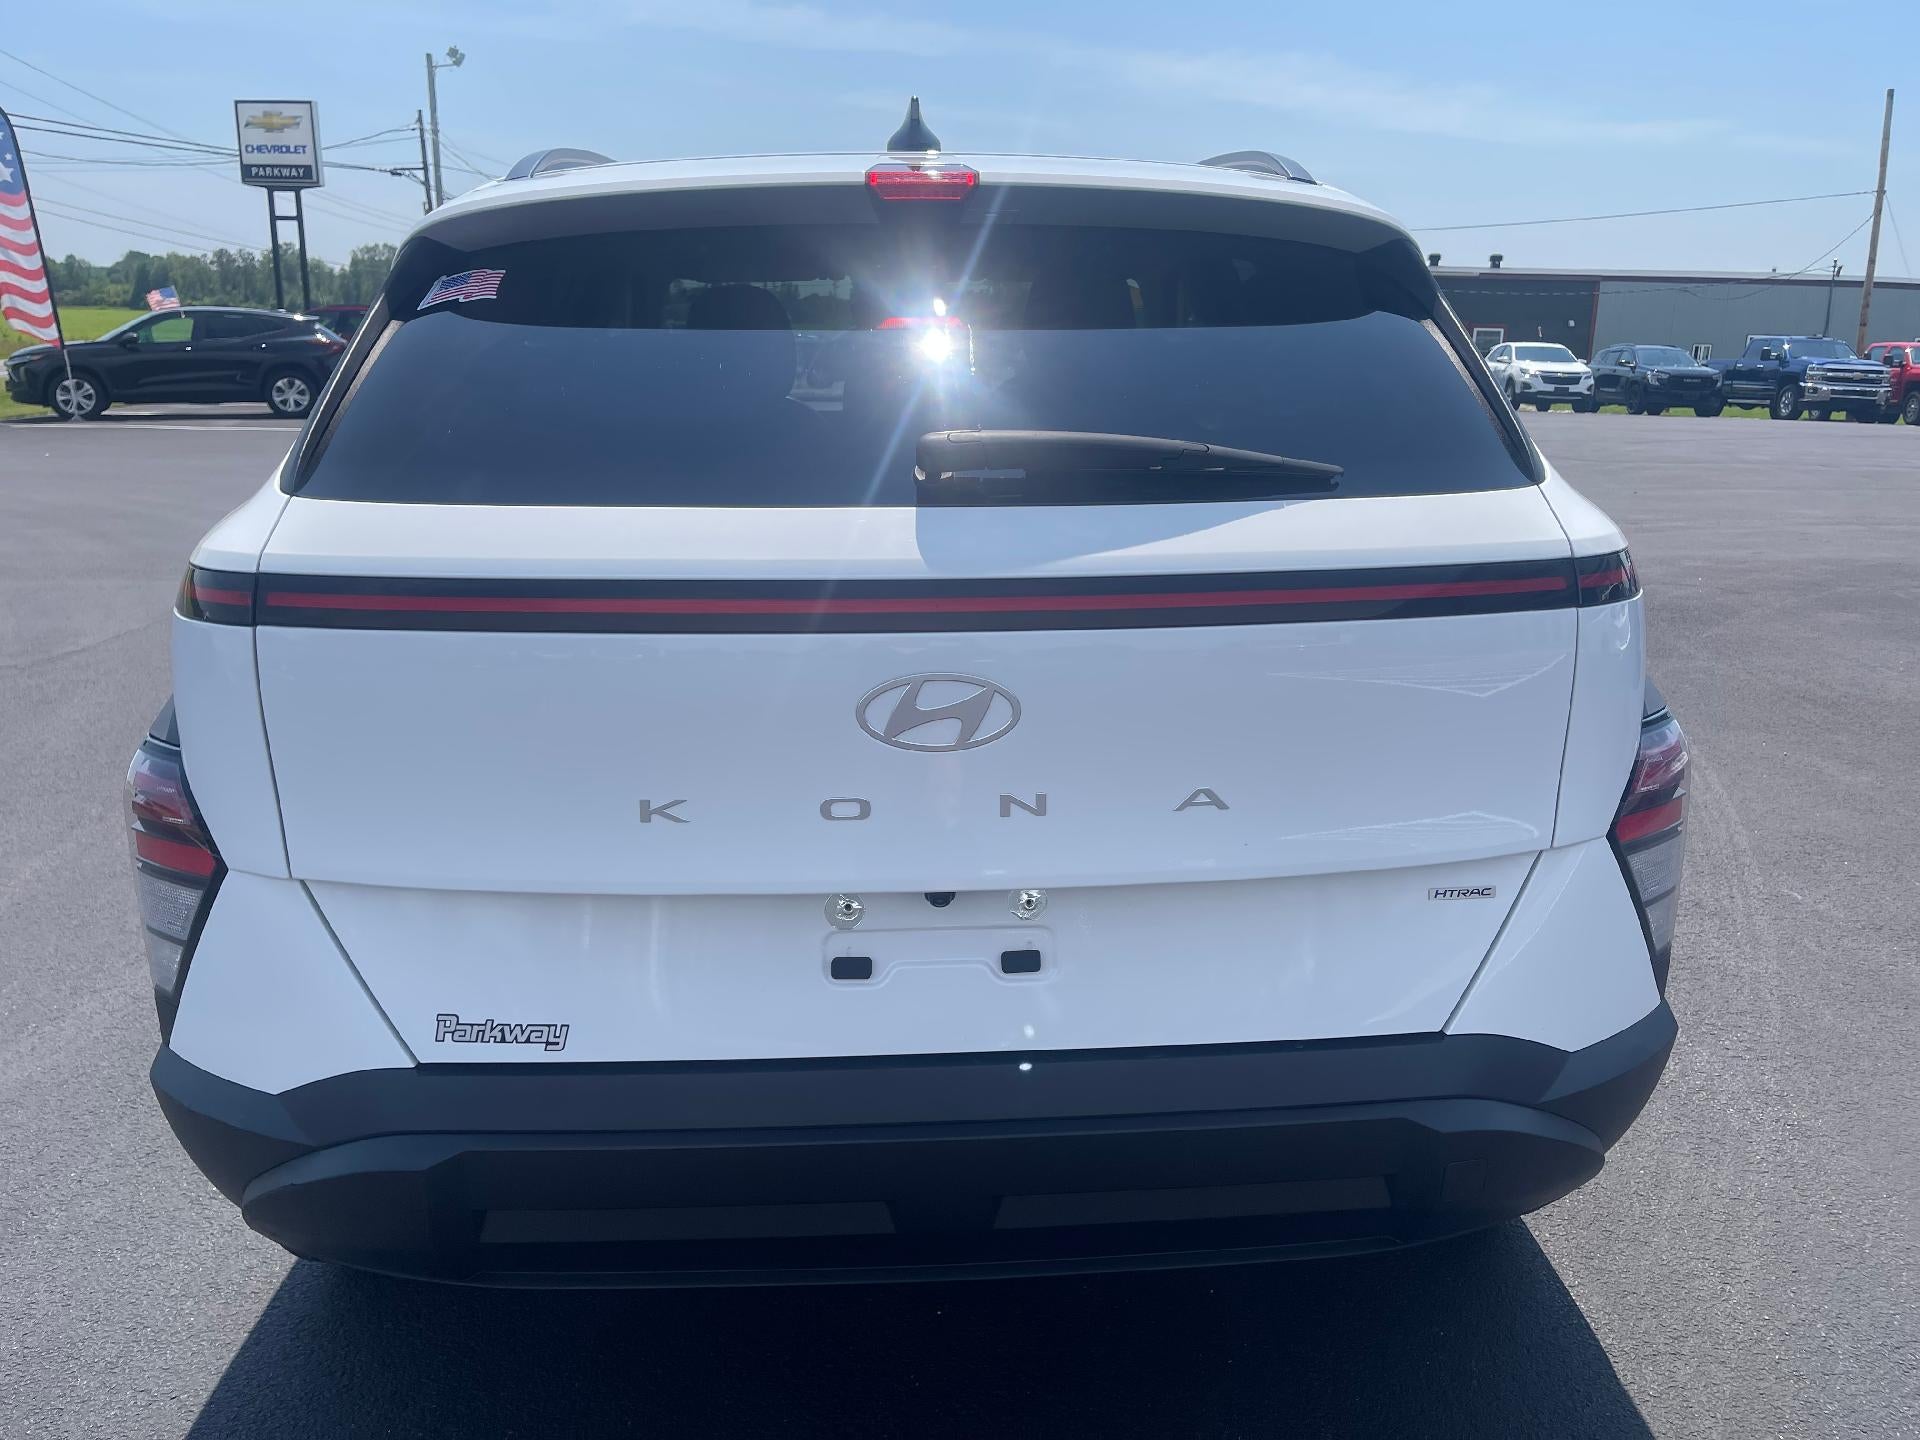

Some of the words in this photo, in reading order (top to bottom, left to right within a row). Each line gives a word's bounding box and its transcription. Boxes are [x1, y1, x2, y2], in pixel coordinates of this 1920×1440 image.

[244, 144, 308, 155] CHEVROLET
[251, 166, 305, 177] PARKWAY
[639, 786, 1230, 823] KONA
[1433, 887, 1493, 899] HTRAC
[435, 1013, 570, 1051] Parkway
